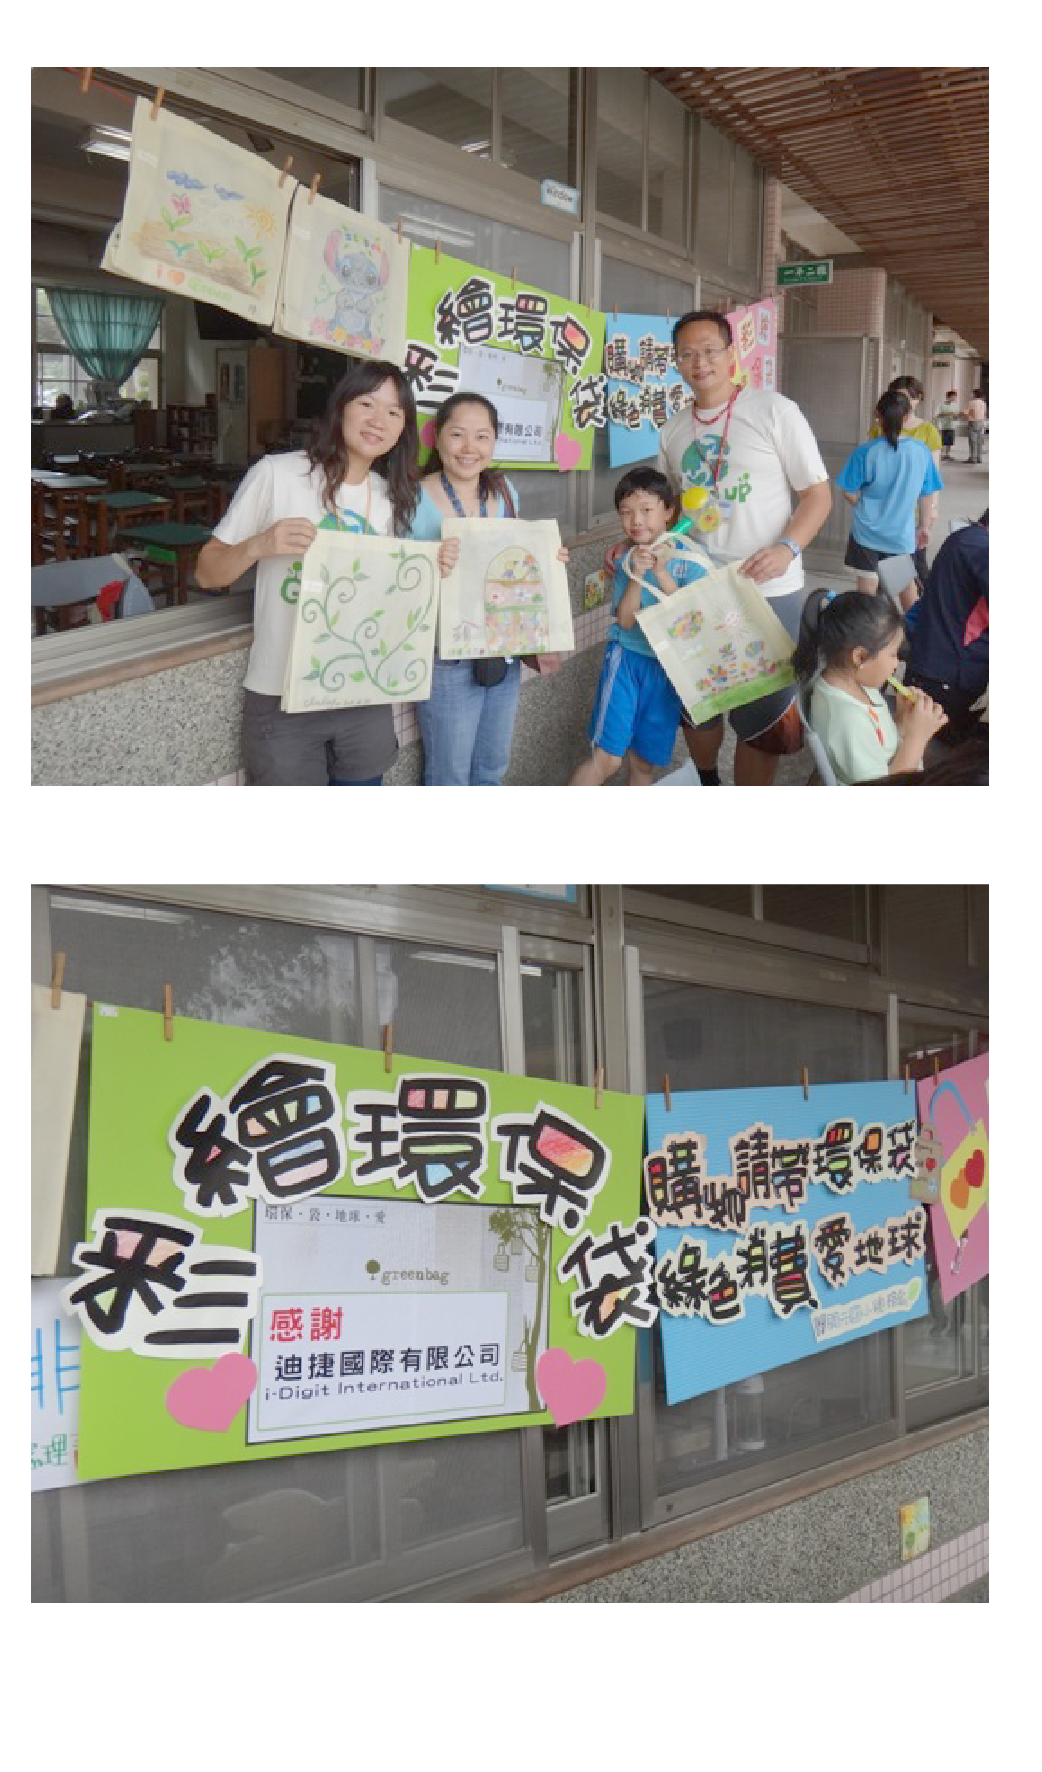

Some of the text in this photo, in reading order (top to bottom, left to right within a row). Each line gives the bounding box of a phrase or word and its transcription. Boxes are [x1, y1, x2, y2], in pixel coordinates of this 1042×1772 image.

[380, 1268, 451, 1286] greenbag
[268, 1305, 345, 1342] 感謝
[274, 1342, 501, 1382] 迪捷國際有限公司
[265, 1371, 504, 1401] i-Digit International Ltd.
